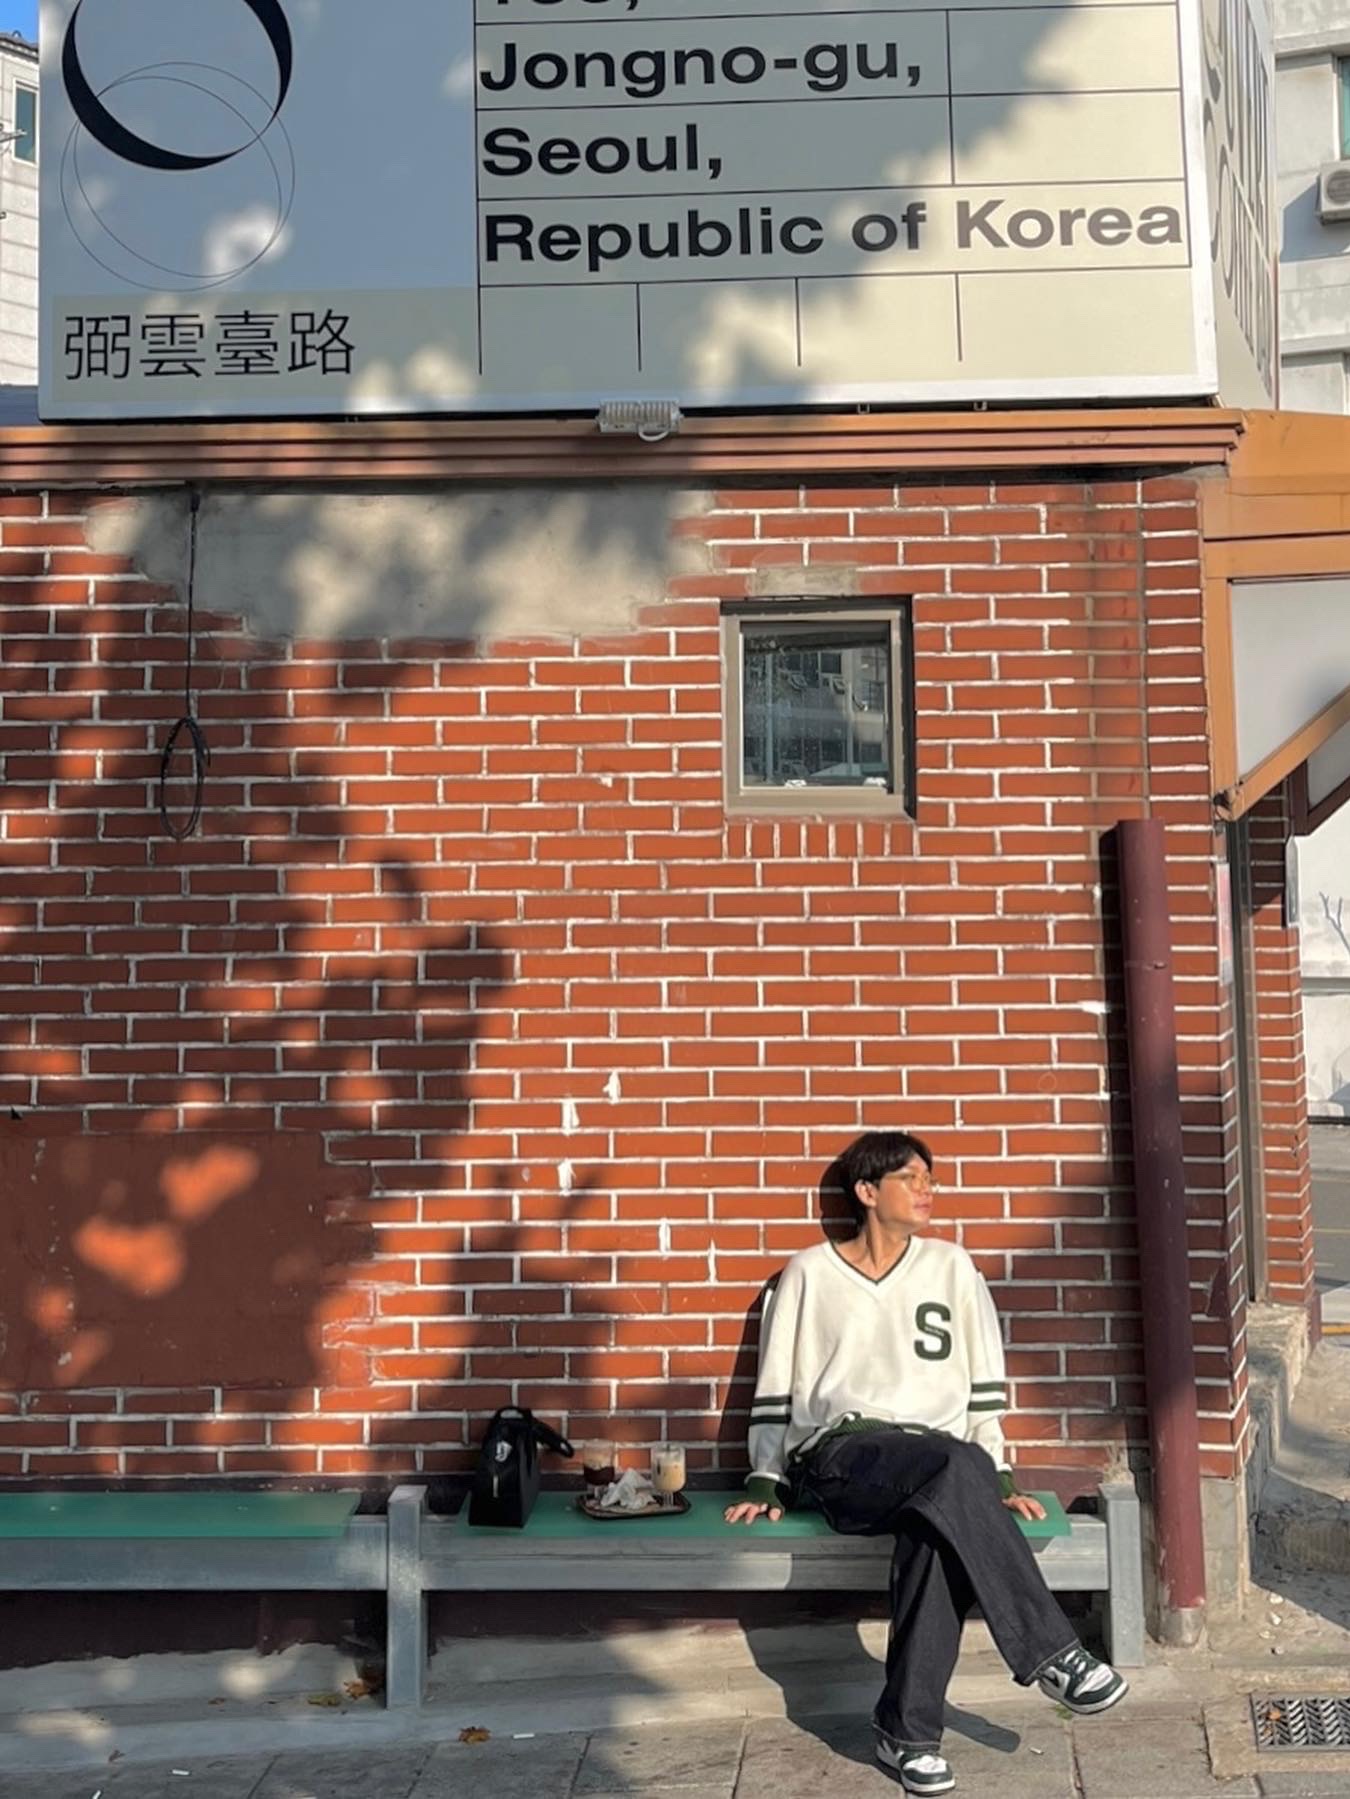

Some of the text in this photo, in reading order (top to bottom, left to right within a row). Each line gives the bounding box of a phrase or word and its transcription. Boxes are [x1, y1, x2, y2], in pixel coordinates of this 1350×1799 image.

[480, 42, 921, 98] Jongno-gu,
[482, 123, 722, 180] Seoul,
[485, 199, 1182, 273] Republic of Korea
[64, 308, 356, 381] 弼雲臺路
[914, 1302, 952, 1361] S
